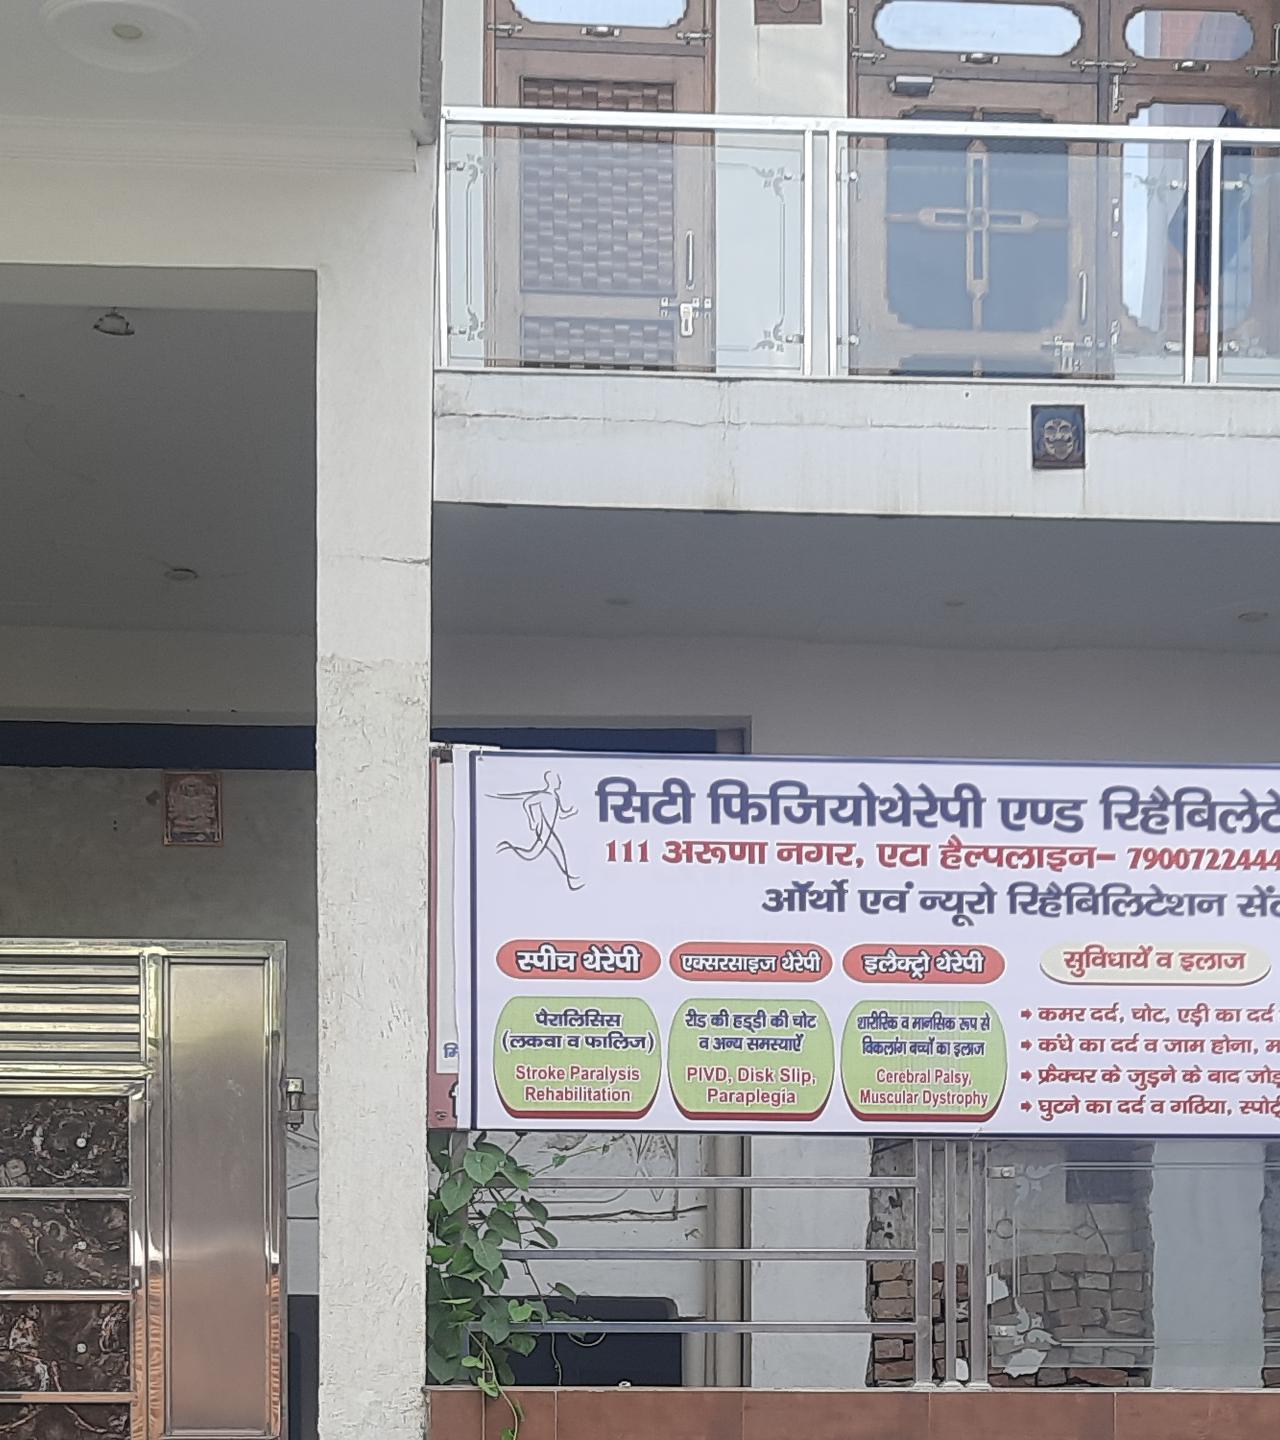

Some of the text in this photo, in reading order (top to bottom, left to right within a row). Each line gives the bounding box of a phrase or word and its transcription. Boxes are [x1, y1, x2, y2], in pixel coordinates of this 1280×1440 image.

[595, 777, 695, 824] सिटी
[708, 778, 986, 830] फिजियोथेरेपी
[998, 798, 1087, 832] एण्ड
[606, 839, 650, 863] 111
[777, 840, 864, 869] नगर,
[878, 843, 930, 869] एटा
[762, 879, 849, 914] ऑर्थो
[859, 882, 916, 914] एवं
[919, 882, 997, 927] न्यूरो
[516, 943, 641, 973] स्पीच थेरेपी
[681, 950, 822, 974] एक्सरसाइज थेरेपी
[935, 949, 983, 974] थेरेपी
[1156, 952, 1173, 969] व
[1179, 953, 1247, 971] इलाज
[536, 1008, 622, 1028] पैरालिसिस
[710, 1009, 729, 1028] की
[770, 1010, 789, 1028] की
[792, 1012, 817, 1029] चोट
[857, 1012, 990, 1031] शारीरिक व मानसिक रूप से
[1038, 1007, 1085, 1022] कमर
[1090, 1002, 1124, 1023] दर्द,
[1132, 1003, 1170, 1024] चोट,
[1215, 1008, 1241, 1022] का
[1246, 1003, 1275, 1023] दर्द
[502, 1031, 654, 1054] (लकवा व फालिज)
[699, 1038, 708, 1050] व
[713, 1037, 742, 1051] अन्य
[863, 1036, 907, 1056] विकलांग
[936, 1040, 951, 1055] का
[954, 1041, 985, 1057] इलाज
[1038, 1033, 1073, 1053] कंधे
[1079, 1039, 1105, 1053] का
[1111, 1033, 1139, 1053] दर्द
[1144, 1039, 1158, 1053] व
[1164, 1039, 1205, 1053] जाम
[1210, 1034, 1259, 1055] होना,
[516, 1065, 640, 1084] Stroke Paralysis
[687, 1067, 816, 1085] PIVD, Disk Slip,
[876, 1069, 972, 1088] Cerebral Palsy,
[1101, 1064, 1121, 1084] के
[1182, 1064, 1201, 1084] के
[525, 1087, 630, 1102] Rehabilitation
[707, 1089, 797, 1107] Paraplegia
[860, 1090, 988, 1108] Muscular Dystrophy
[1038, 1095, 1080, 1121] घुटने
[1086, 1100, 1111, 1114] का
[1117, 1095, 1146, 1114] दर्द
[1150, 1100, 1165, 1114] व
[1170, 1095, 1232, 1116] गठिया,
